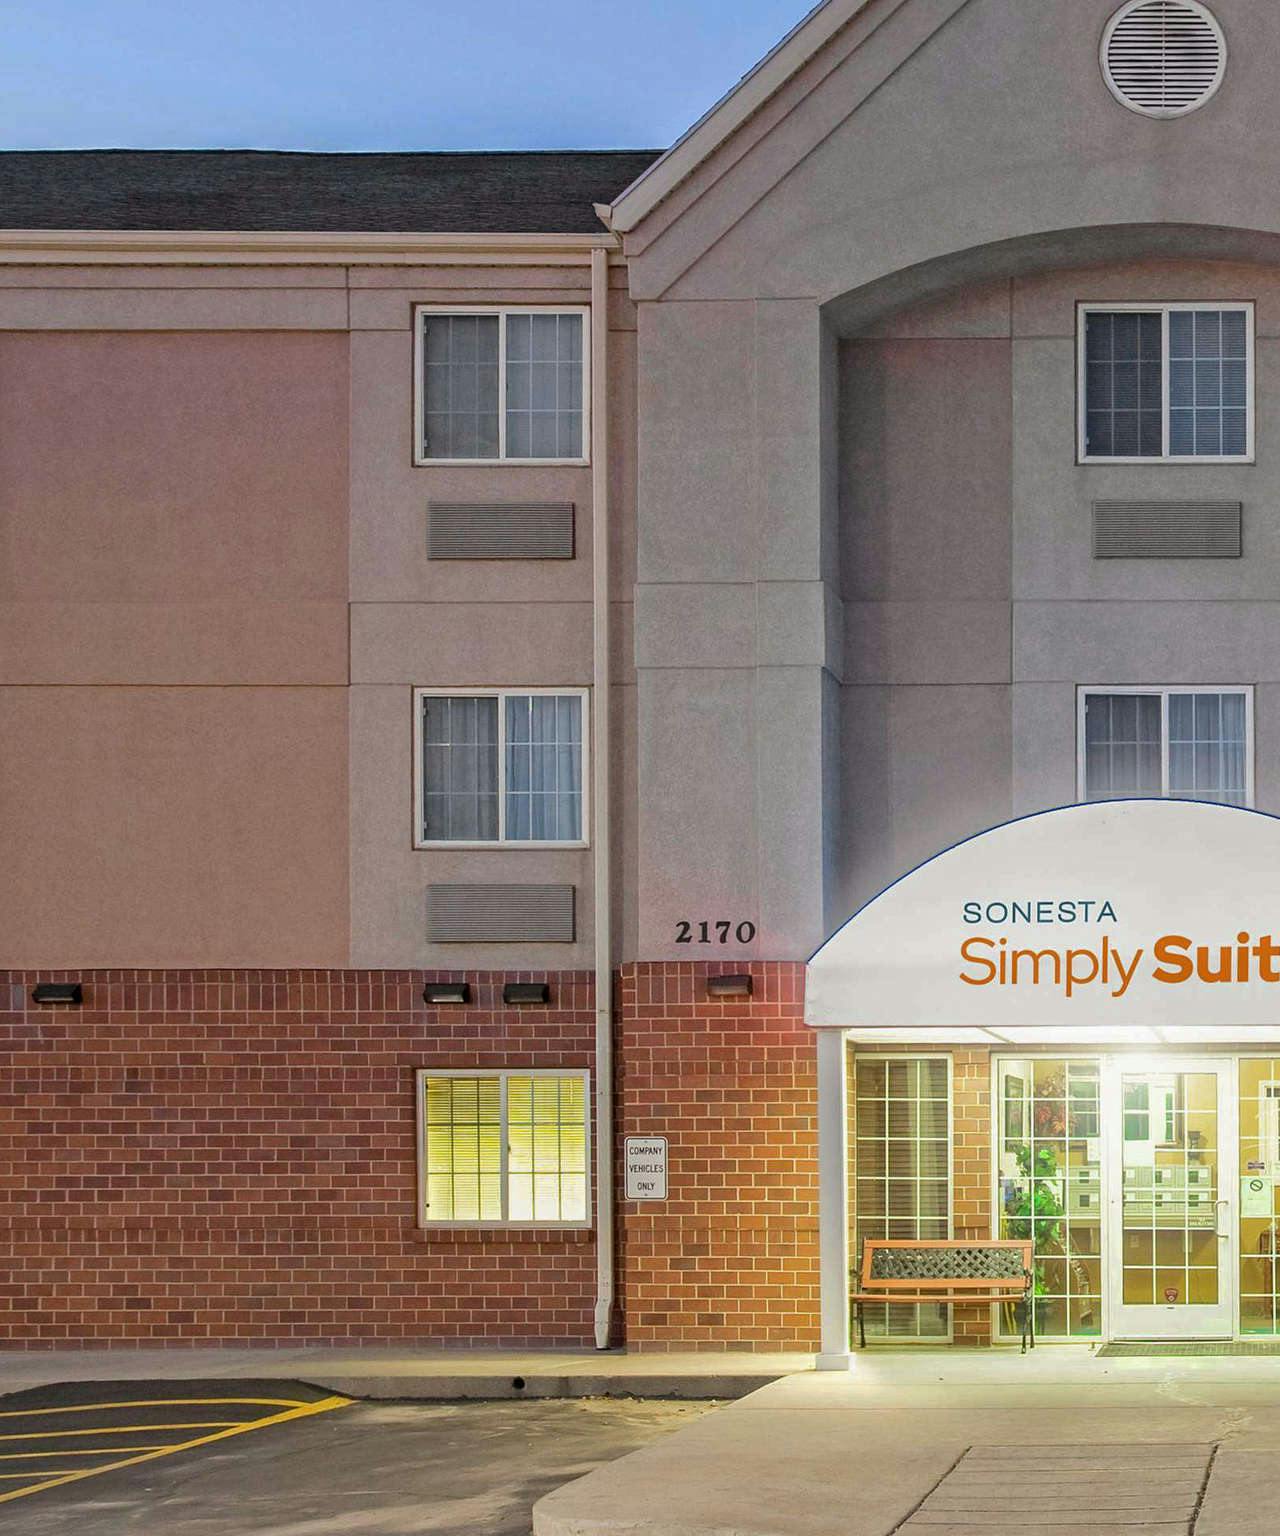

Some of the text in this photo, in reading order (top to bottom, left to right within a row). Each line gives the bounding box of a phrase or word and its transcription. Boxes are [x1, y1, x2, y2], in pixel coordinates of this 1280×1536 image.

[962, 900, 1118, 924] SONESTA
[675, 921, 756, 944] 2170
[958, 935, 1144, 998] Simply
[629, 1146, 663, 1156] COMPANY
[629, 1164, 664, 1173] VEHICLES
[637, 1181, 656, 1191] ONLY
